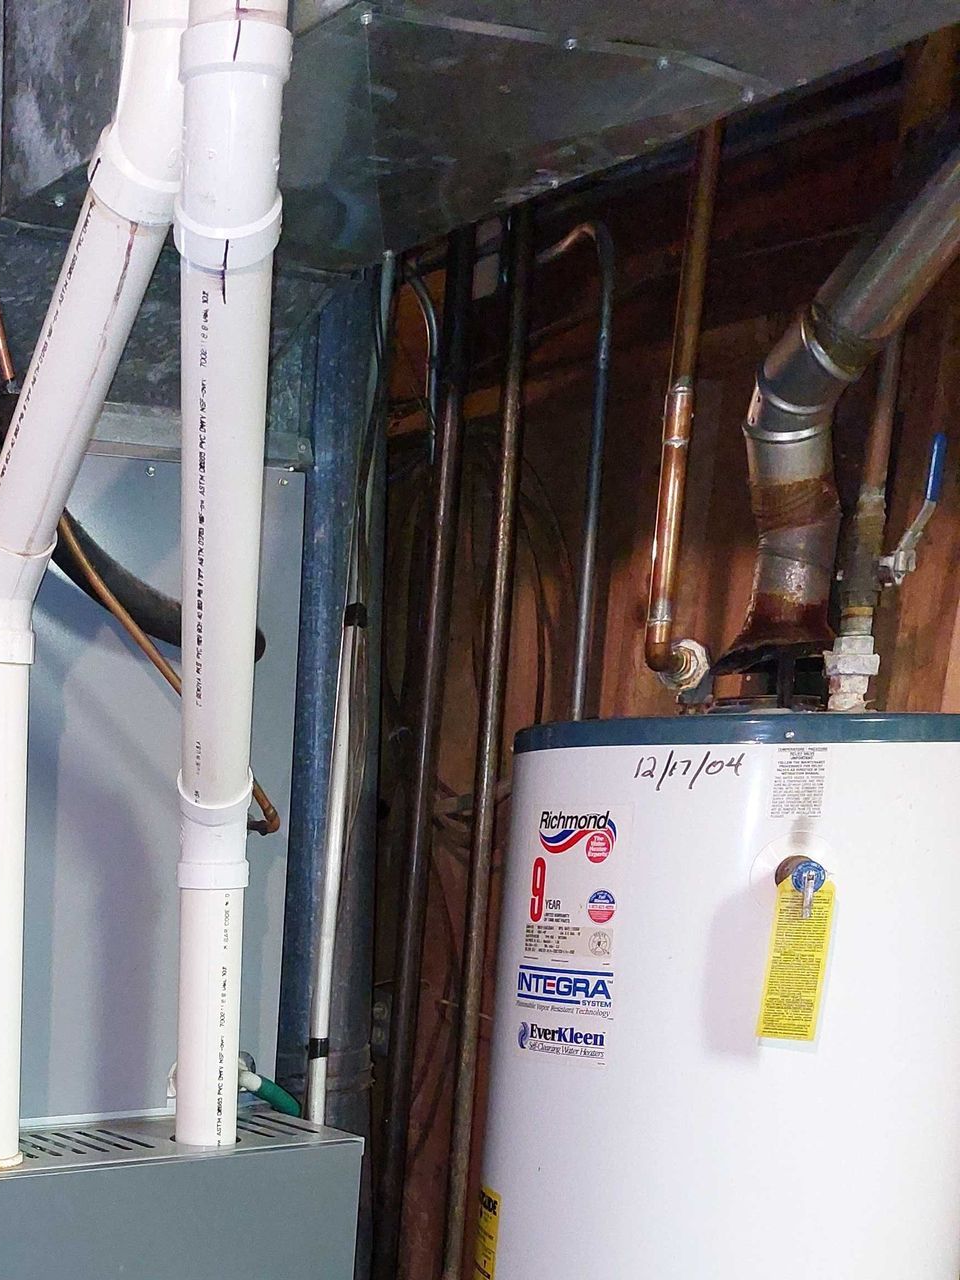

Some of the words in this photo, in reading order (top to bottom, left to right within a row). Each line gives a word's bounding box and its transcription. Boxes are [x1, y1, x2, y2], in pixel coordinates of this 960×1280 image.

[198, 433, 206, 450] PVC
[198, 474, 206, 496] ASTM
[633, 749, 746, 791] 12/17/04
[539, 810, 610, 830] Richmond
[529, 856, 547, 923] 9
[545, 899, 561, 910] YEAR
[517, 971, 612, 1000] INTEGRA
[575, 1007, 611, 1019] Technology
[581, 999, 612, 1008] SYSTEM
[529, 1023, 605, 1047] EverKleen
[561, 1044, 580, 1056] Water
[580, 1046, 605, 1059] Heaters
